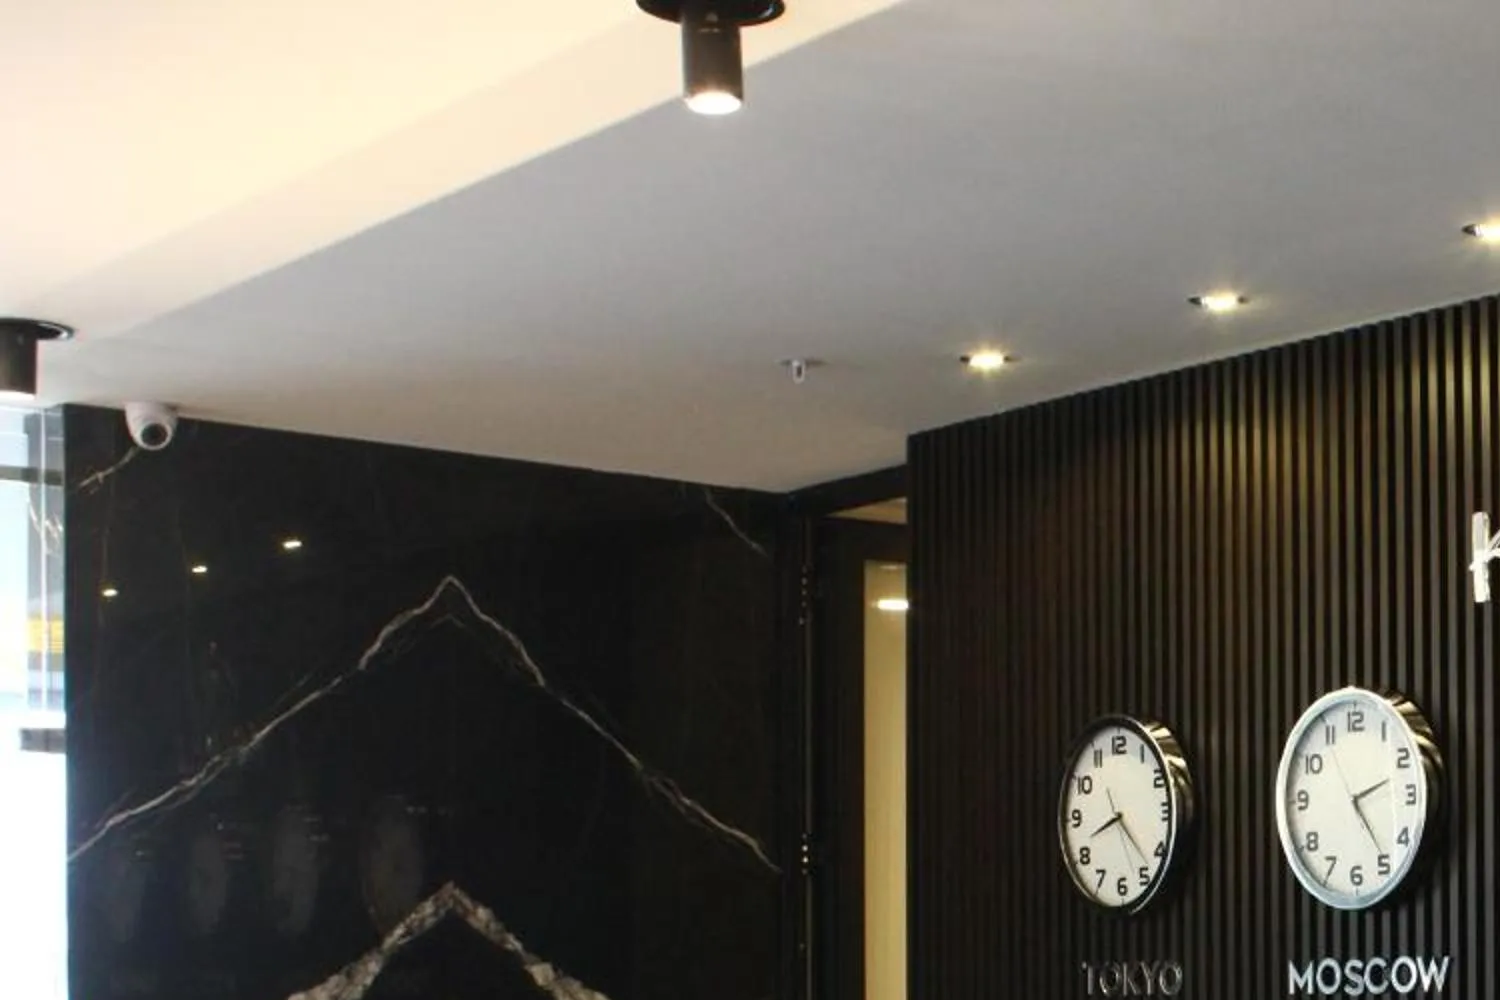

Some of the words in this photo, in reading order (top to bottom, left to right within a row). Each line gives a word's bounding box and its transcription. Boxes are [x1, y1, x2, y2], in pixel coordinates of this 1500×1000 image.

[1347, 711, 1365, 733] 12
[1381, 721, 1386, 742] 1
[1325, 725, 1336, 745] 11
[1112, 736, 1127, 755] 12
[1140, 744, 1145, 764] 1
[1093, 748, 1103, 768] 11
[1305, 753, 1323, 775] 10
[1396, 747, 1410, 769] 2
[1077, 775, 1093, 795] 10
[1153, 769, 1166, 788] 2
[1297, 790, 1309, 811] 9
[1405, 783, 1417, 806] 3
[1071, 809, 1082, 828] 9
[1305, 831, 1319, 851] 8
[1396, 827, 1410, 847] 4
[1080, 846, 1091, 865] 8
[1154, 841, 1165, 858] 4
[1325, 856, 1337, 878] 7
[1377, 854, 1391, 875] 5
[1095, 869, 1107, 889] 7
[1139, 867, 1150, 888] 5
[1350, 865, 1363, 886] 6
[1117, 877, 1128, 896] 6
[1081, 960, 1183, 996] TOKYO
[1287, 955, 1450, 994] MOSCOW
